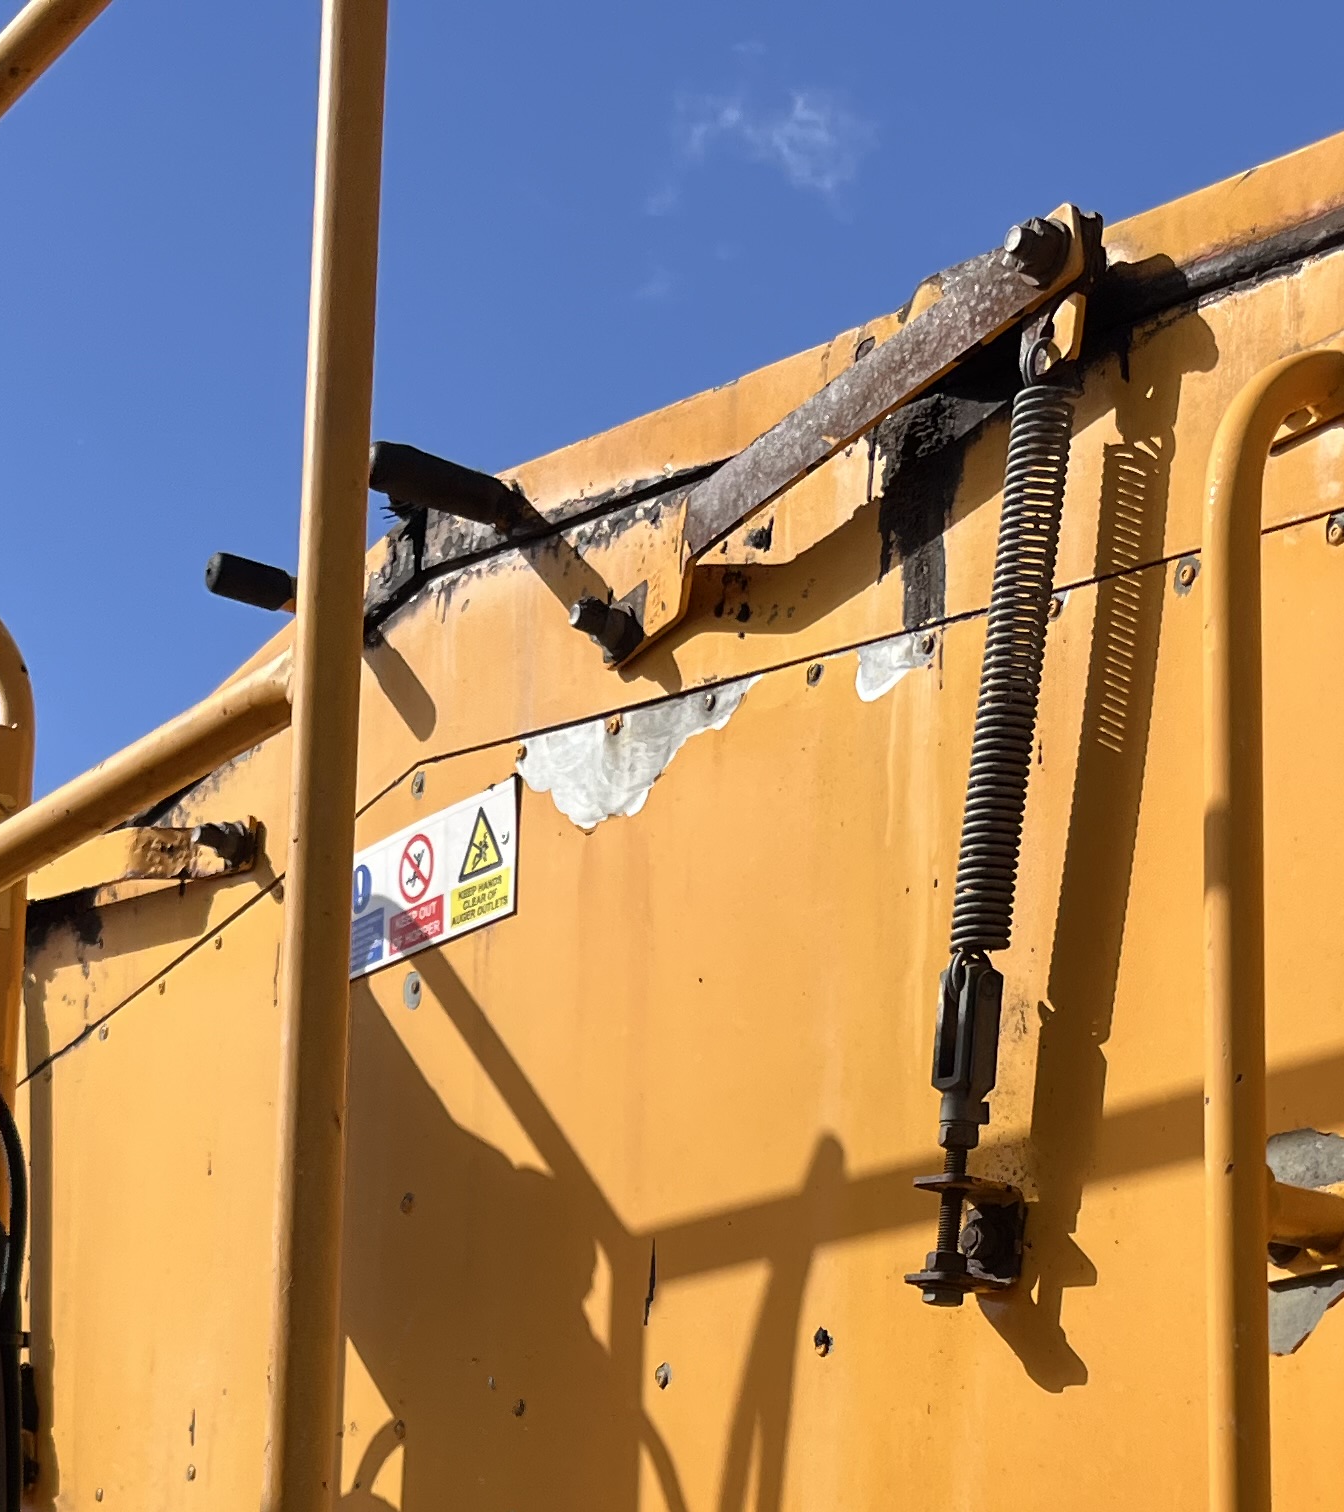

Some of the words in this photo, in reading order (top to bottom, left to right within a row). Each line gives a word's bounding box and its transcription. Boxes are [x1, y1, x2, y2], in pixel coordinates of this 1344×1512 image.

[458, 886, 476, 900] KEEP
[478, 875, 502, 892] HANDS
[463, 893, 486, 910] CLEAR
[487, 888, 497, 900] OF
[396, 910, 418, 927] KEEP
[419, 901, 437, 920] OUT
[452, 909, 475, 925] AUGER
[477, 895, 508, 916] OUTLETS
